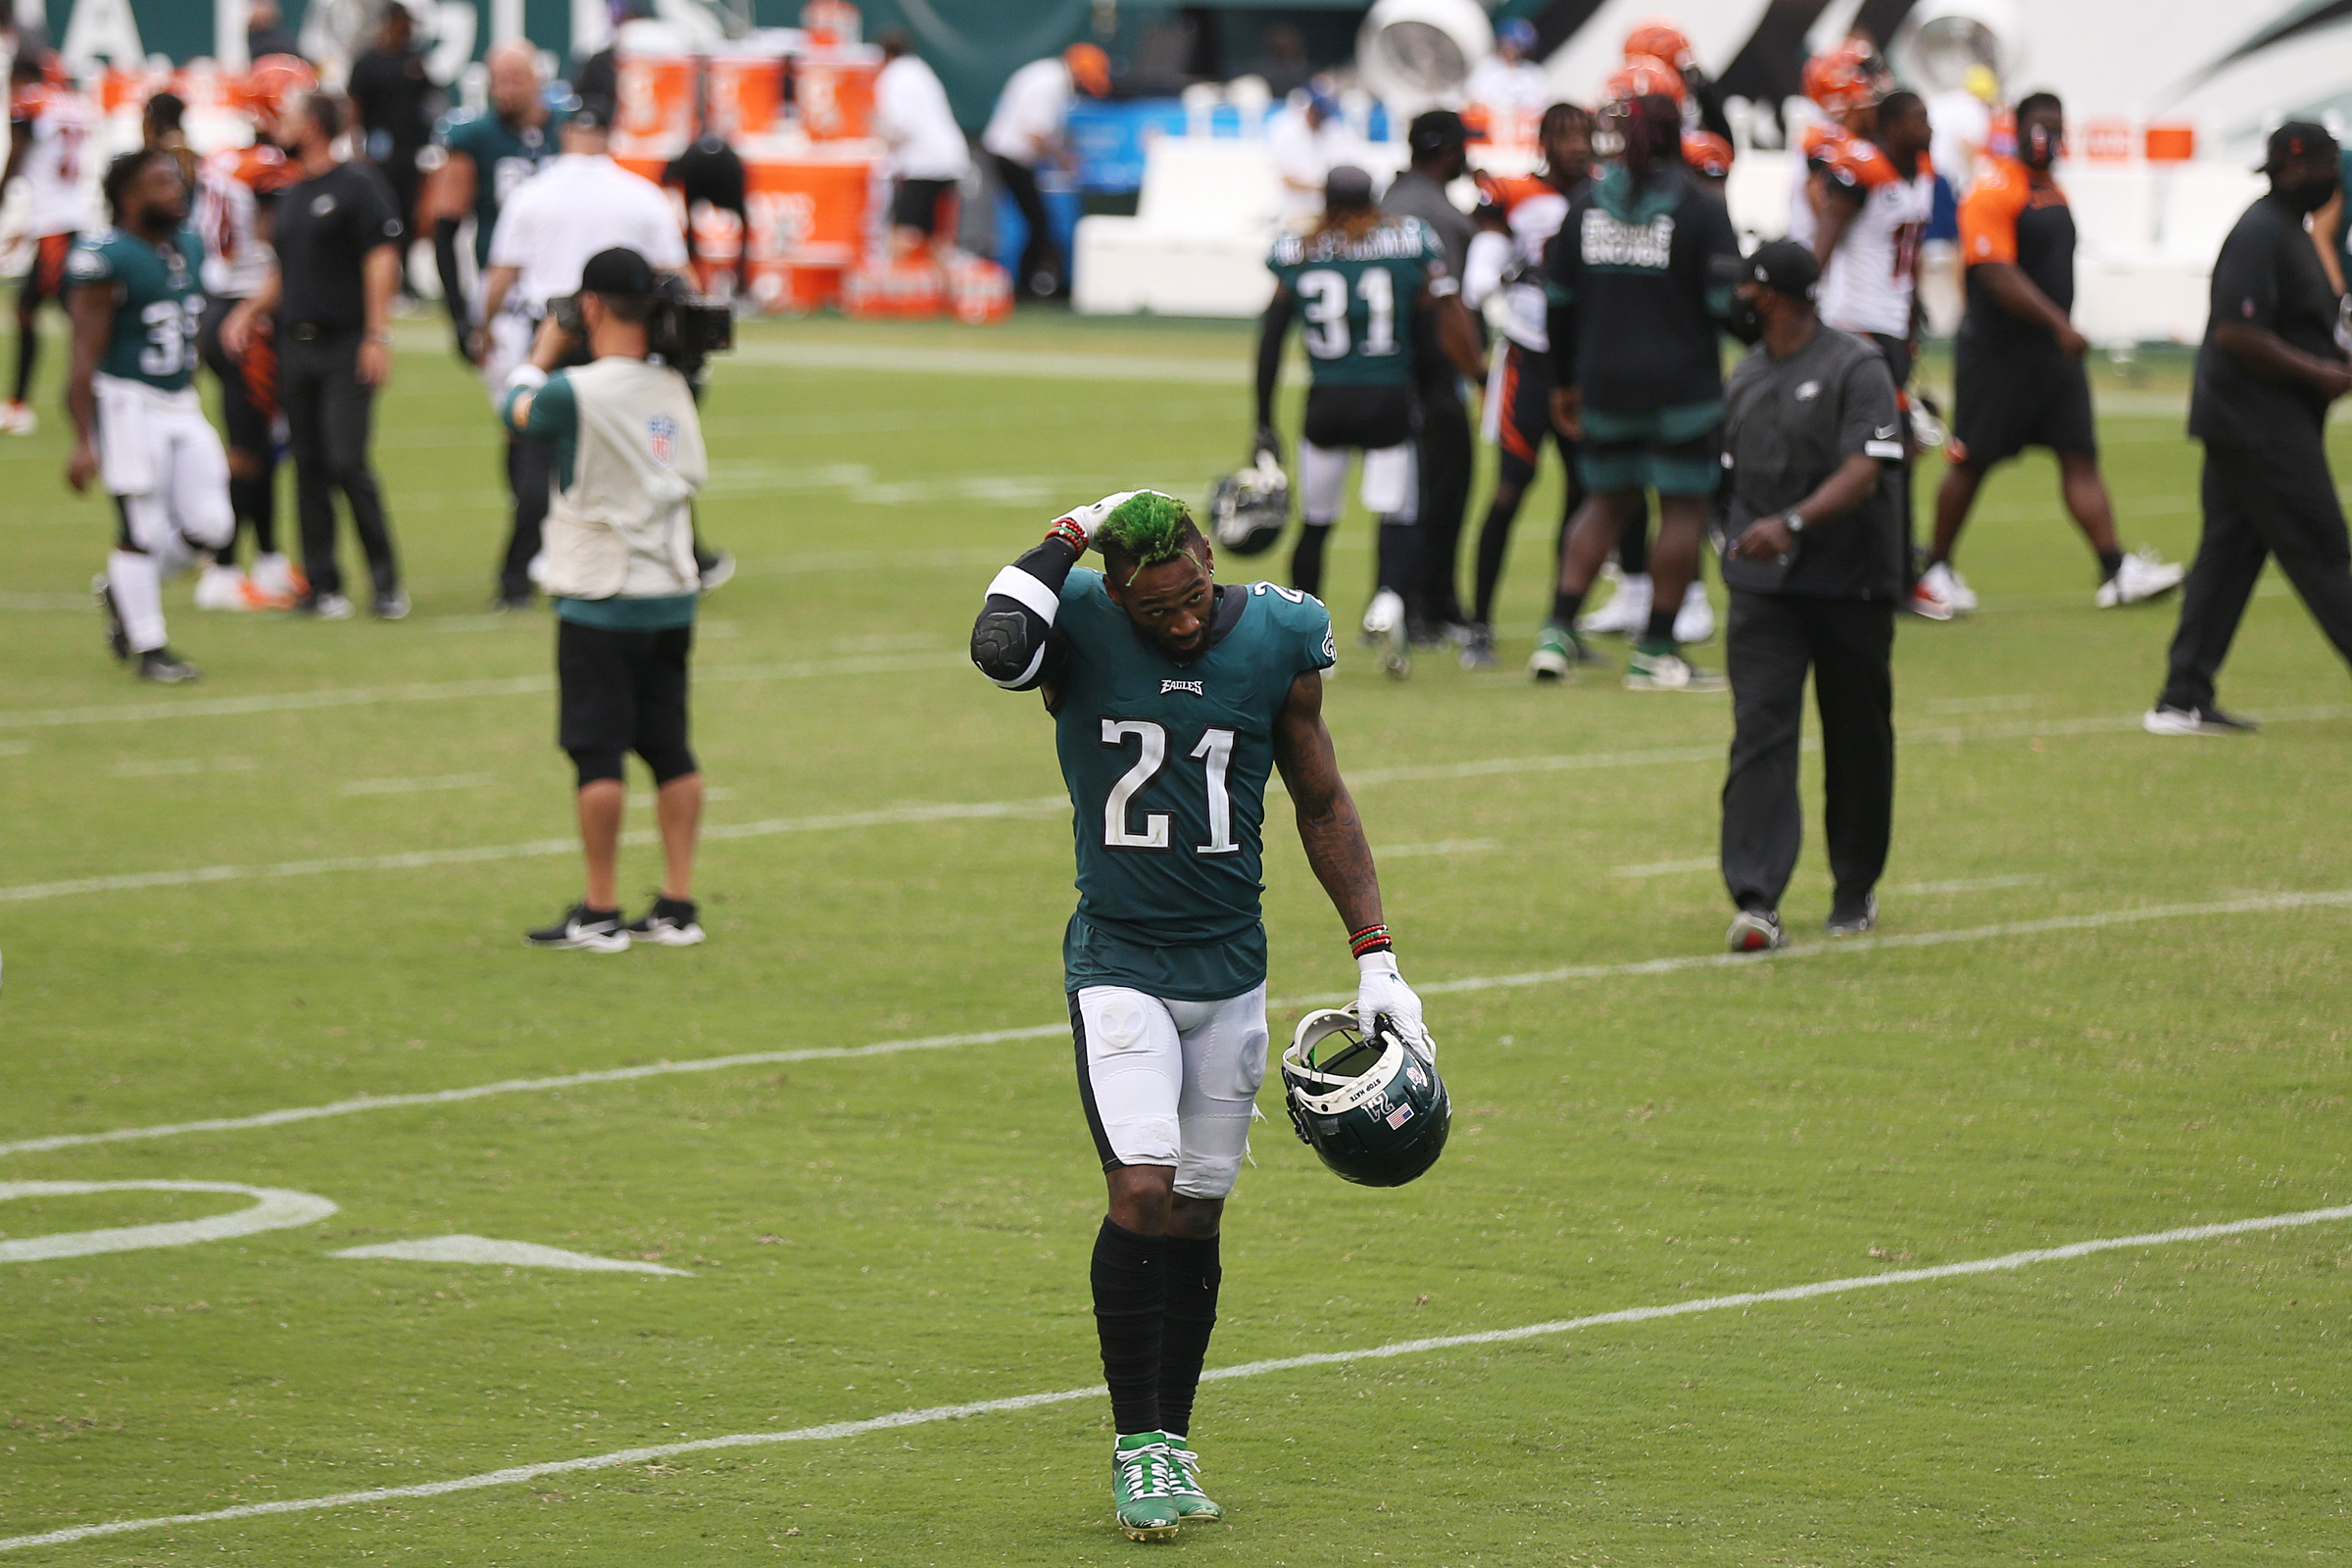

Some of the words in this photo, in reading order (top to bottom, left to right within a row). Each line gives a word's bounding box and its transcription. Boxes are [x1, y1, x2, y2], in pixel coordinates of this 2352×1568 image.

[1296, 267, 1401, 360] 31
[1160, 679, 1203, 696] EAGLES
[1101, 718, 1241, 855] 21
[1365, 1078, 1382, 1092] STOP
[1349, 1091, 1365, 1102] HATE
